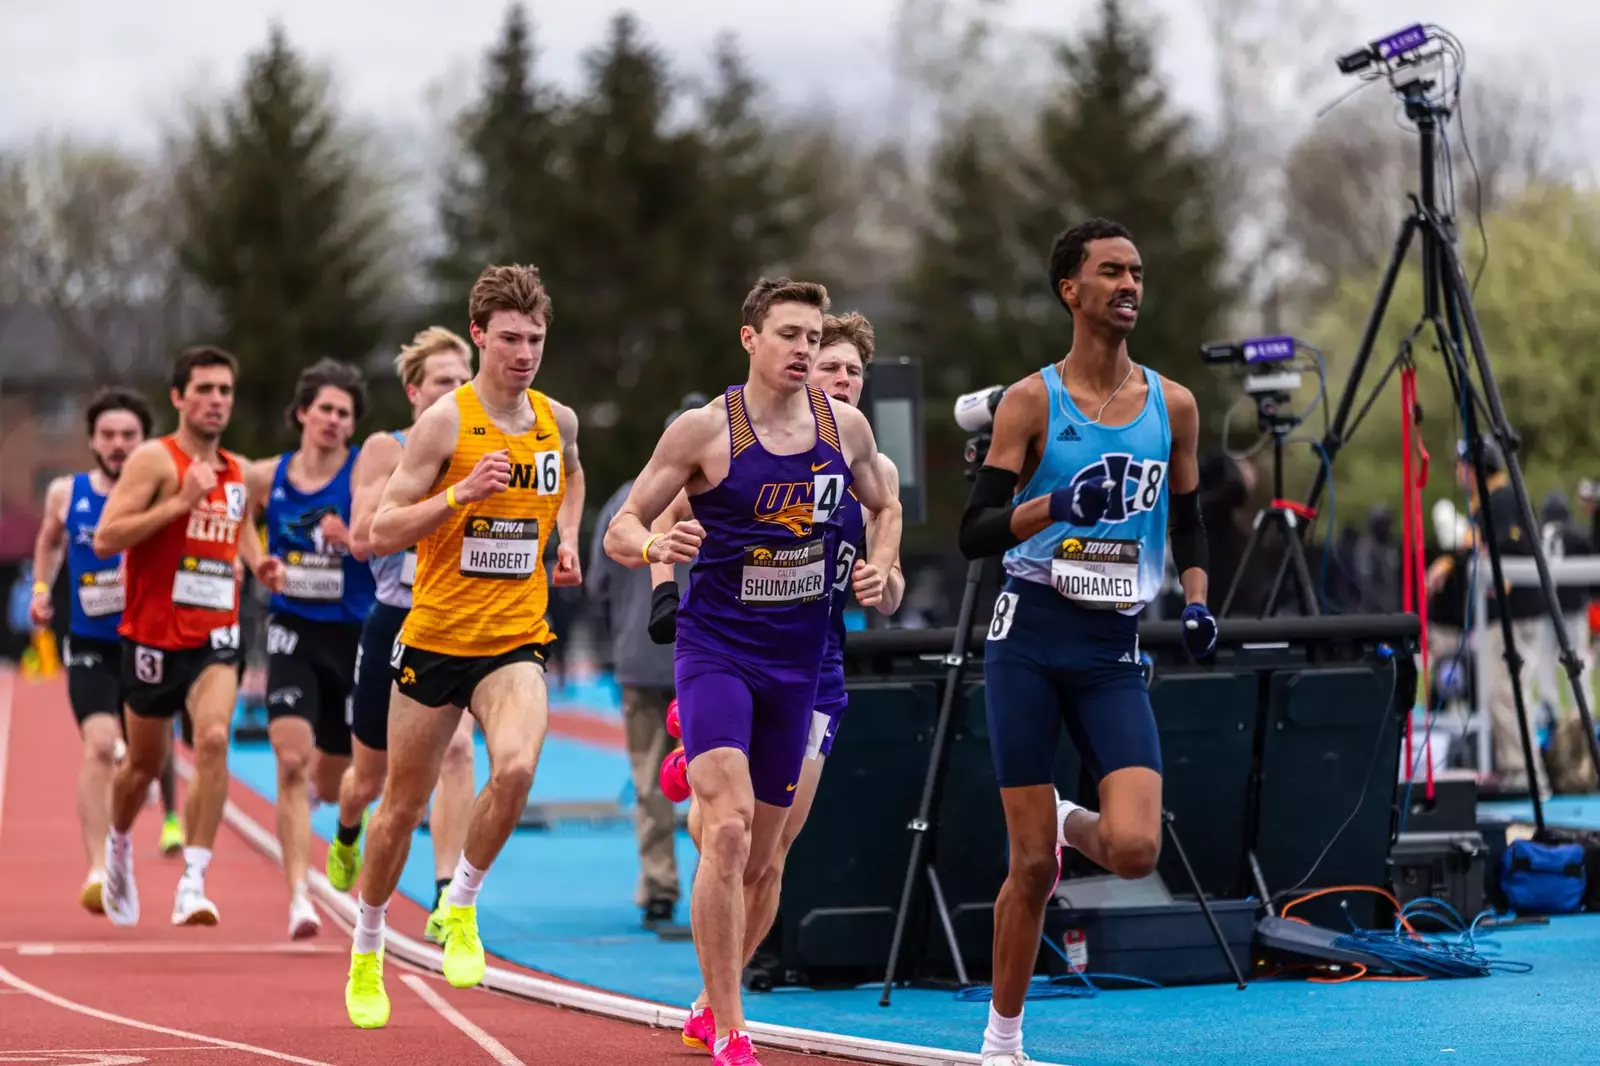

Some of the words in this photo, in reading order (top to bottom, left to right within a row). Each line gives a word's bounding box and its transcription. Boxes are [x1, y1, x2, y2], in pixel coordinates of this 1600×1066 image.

[543, 453, 557, 493] 6
[817, 478, 838, 518] 4
[1142, 464, 1161, 508] 8
[754, 482, 815, 517] UN
[491, 521, 525, 533] IOWA
[469, 550, 531, 569] HARBERT
[773, 546, 809, 560] IOWA
[1083, 541, 1123, 555] IOWA
[777, 569, 797, 578] CALEB
[836, 545, 855, 584] 5
[744, 574, 822, 597] SHUMAKER
[1056, 574, 1133, 597] MOHAMED
[991, 594, 1010, 638] 8
[140, 652, 157, 680] 3
